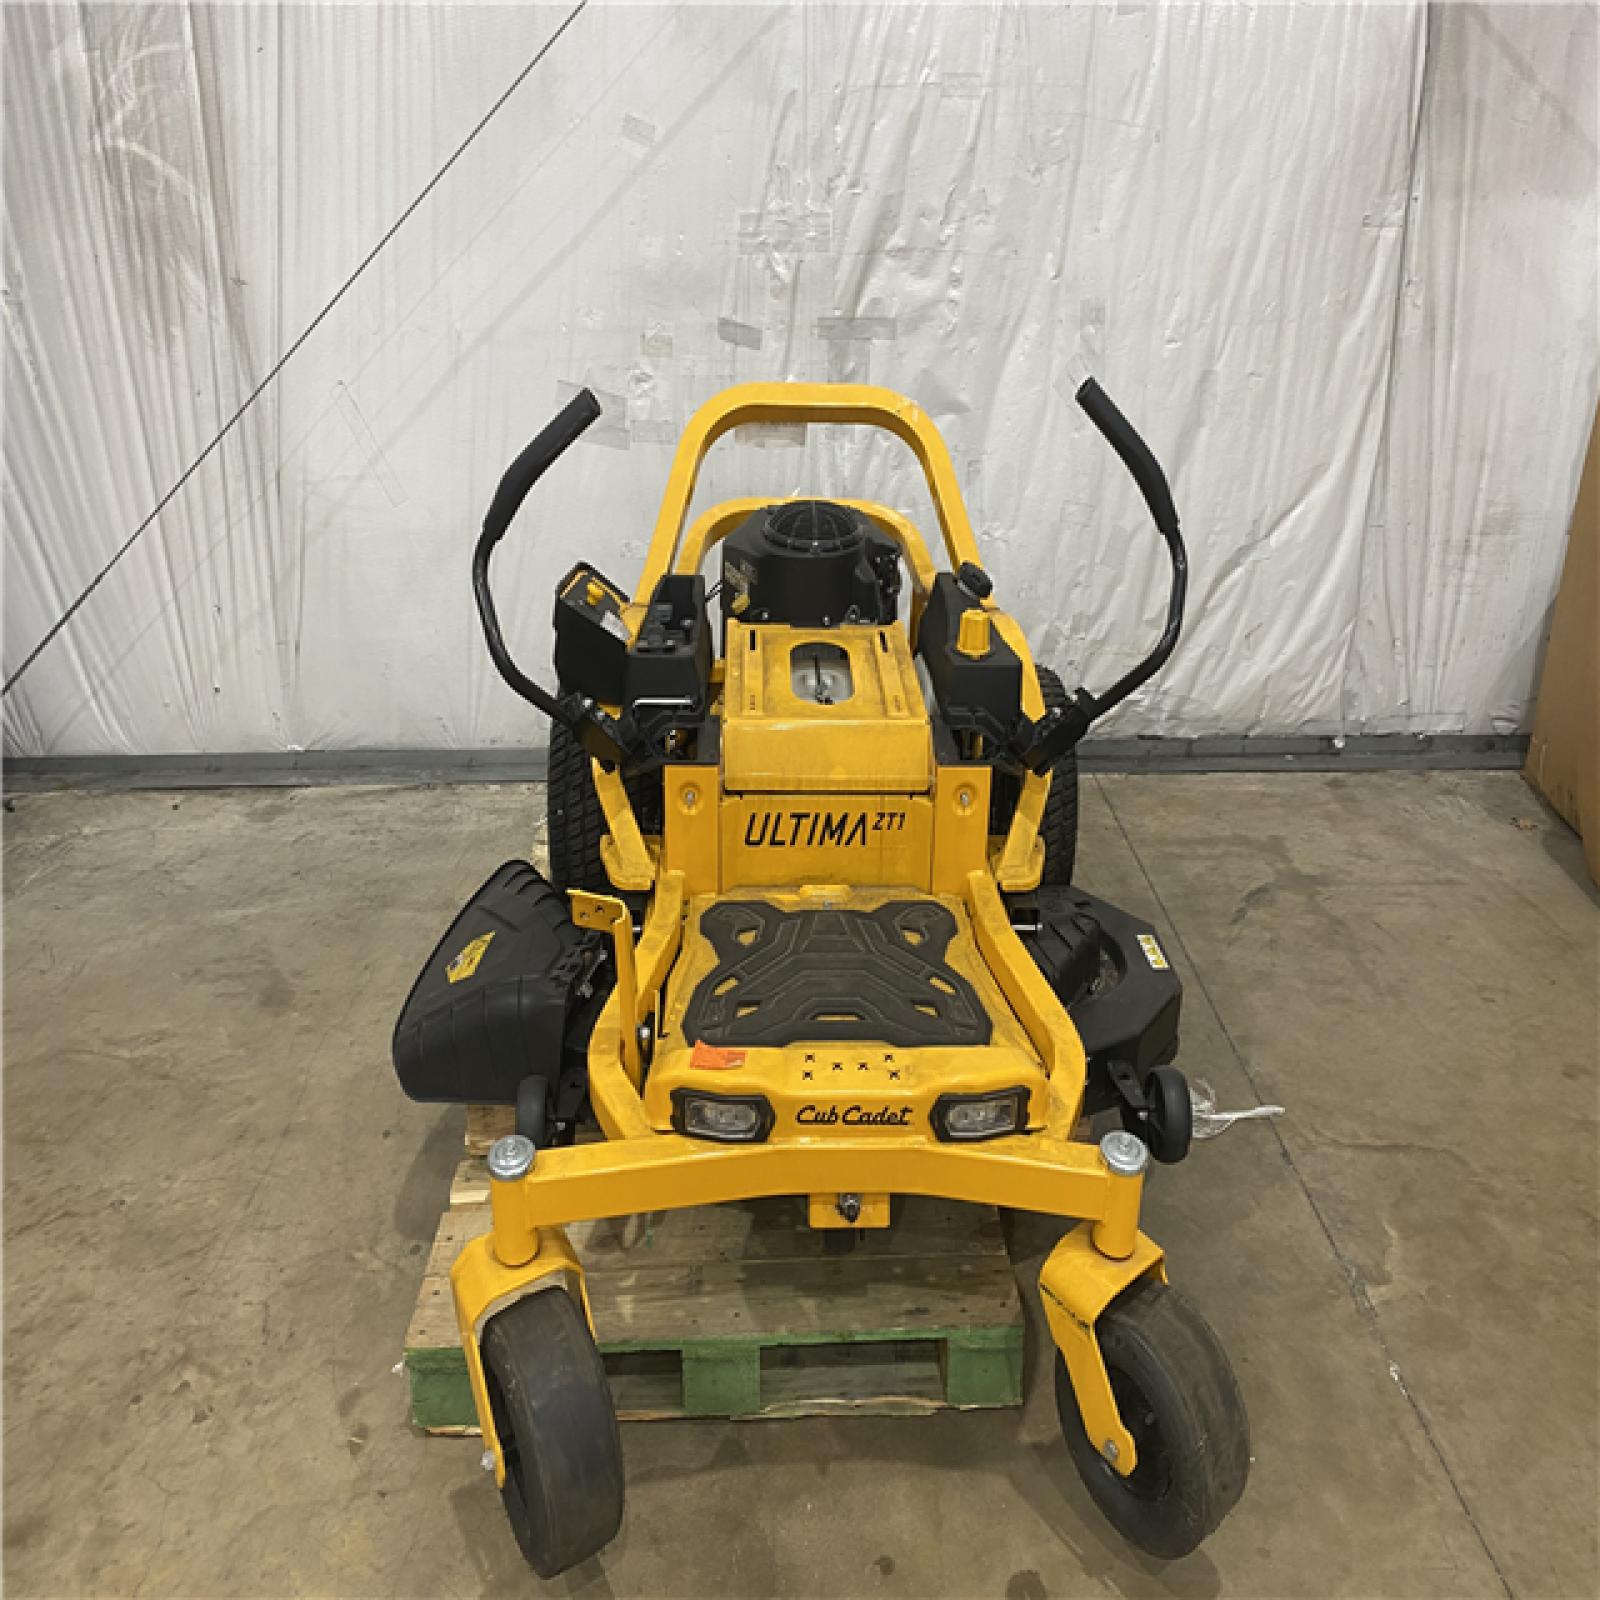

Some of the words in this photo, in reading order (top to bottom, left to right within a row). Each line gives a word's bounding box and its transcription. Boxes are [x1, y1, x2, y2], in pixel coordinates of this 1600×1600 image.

[745, 812, 867, 846] ULTIMA
[872, 812, 906, 831] ZT1
[796, 1105, 839, 1126] Cub
[842, 1105, 913, 1126] Cadet
